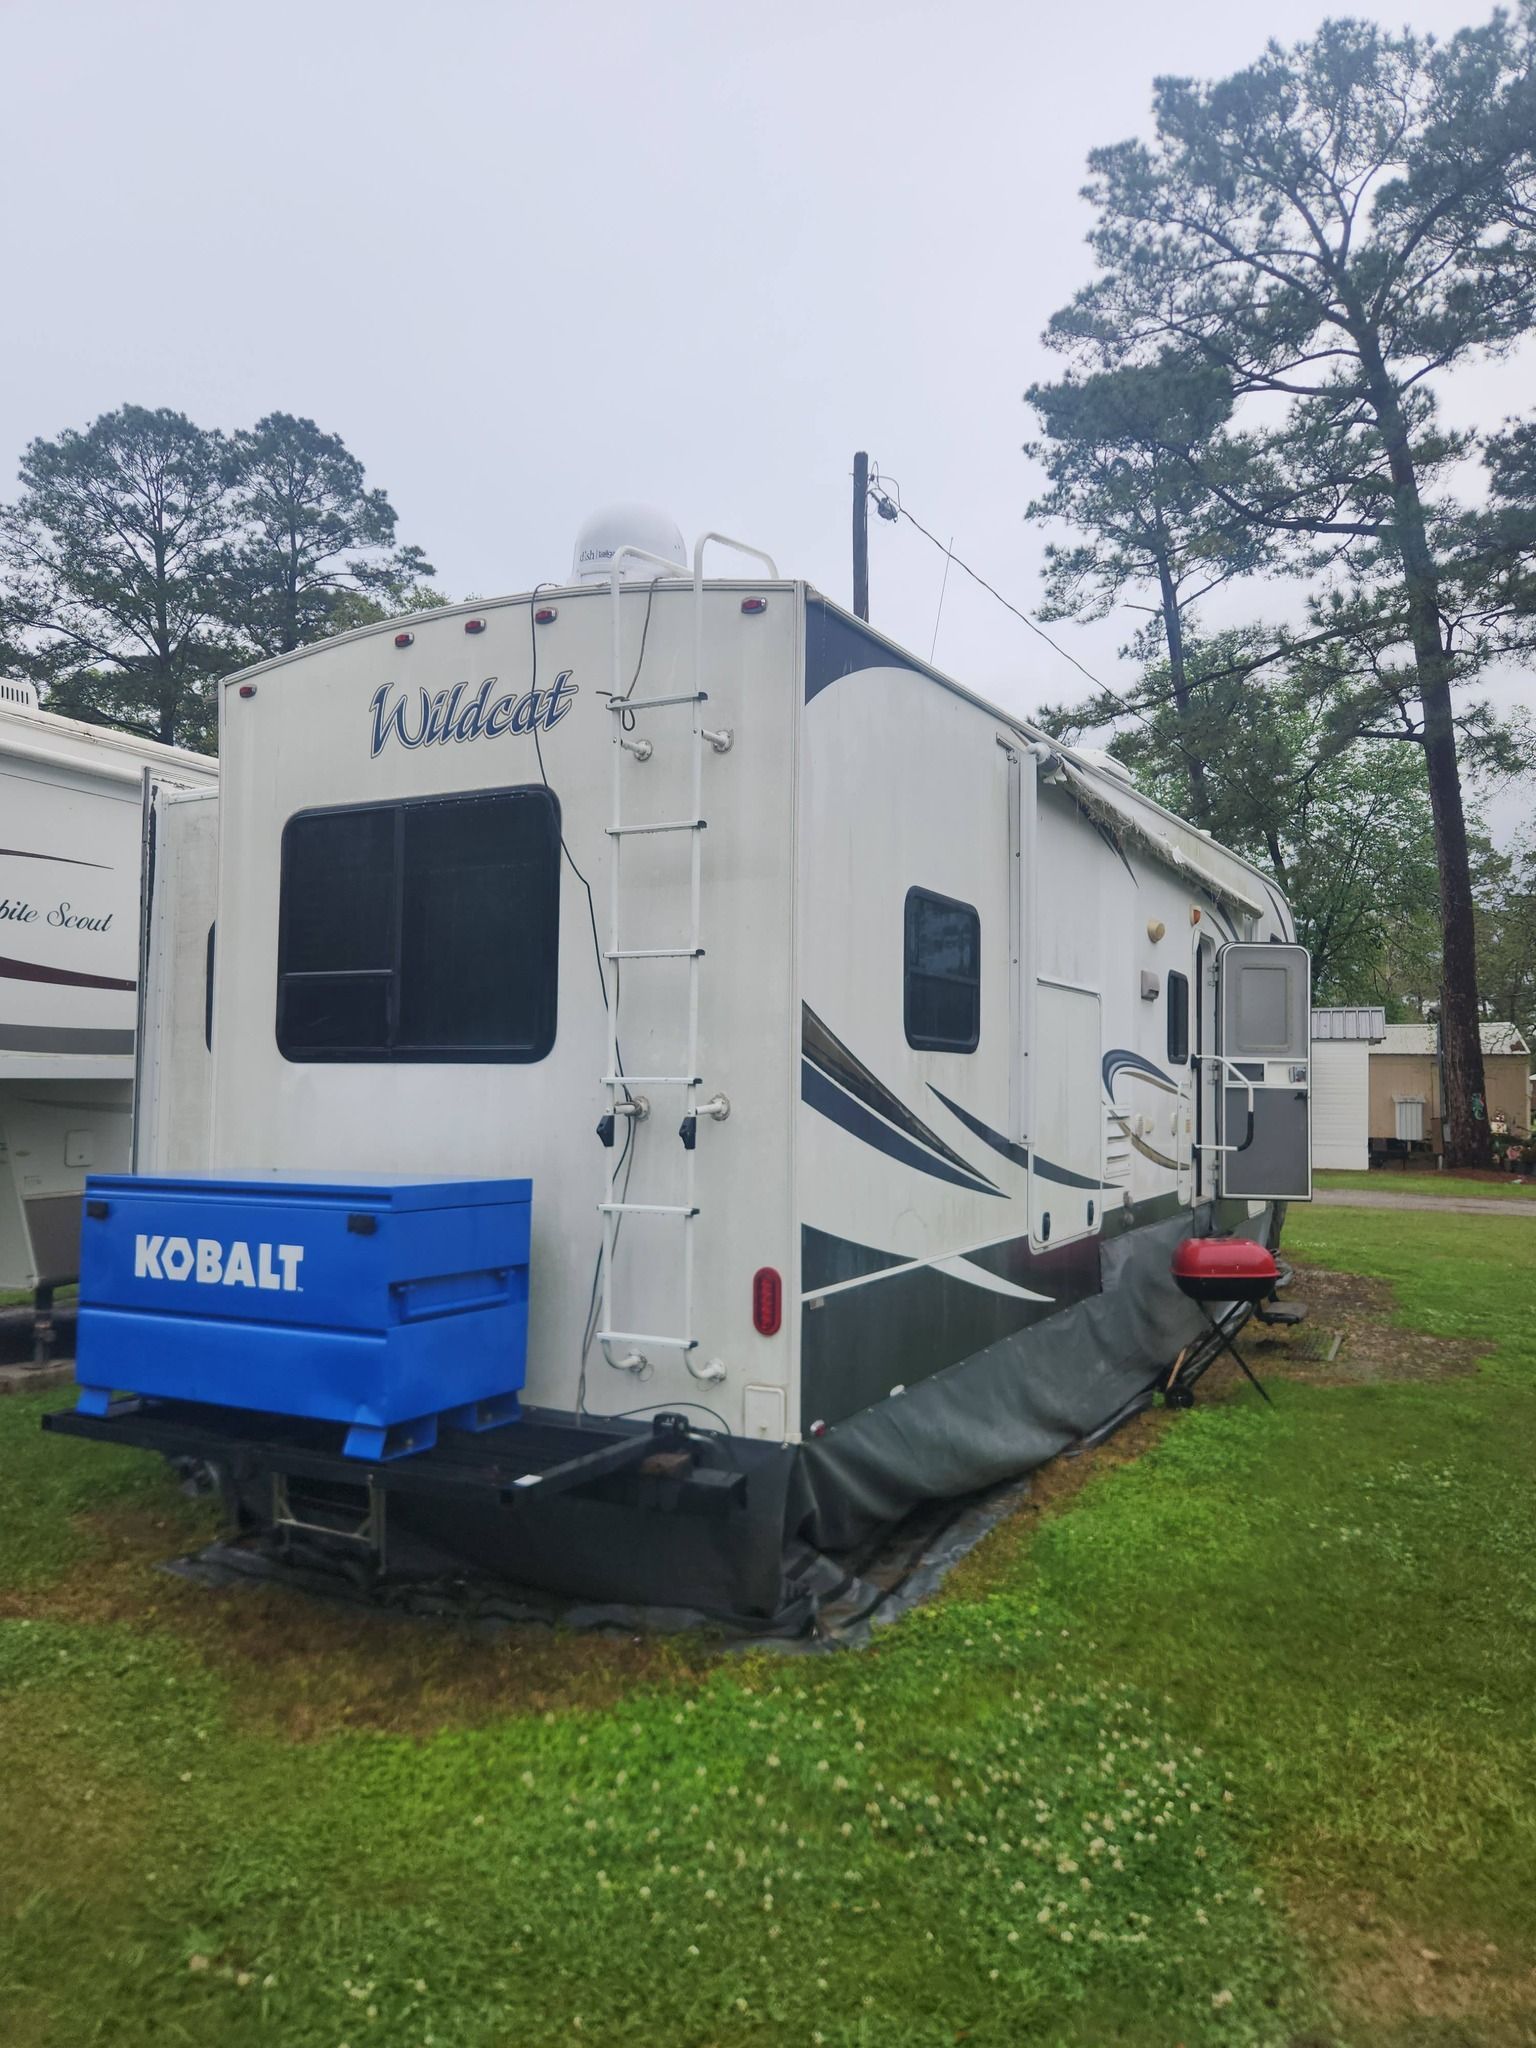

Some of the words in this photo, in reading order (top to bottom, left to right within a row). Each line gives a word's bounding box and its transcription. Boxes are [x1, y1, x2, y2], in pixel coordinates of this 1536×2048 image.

[580, 550, 595, 562] dish
[369, 669, 579, 759] Wildcat
[47, 902, 113, 932] Scout
[134, 1234, 304, 1291] KOBALT
